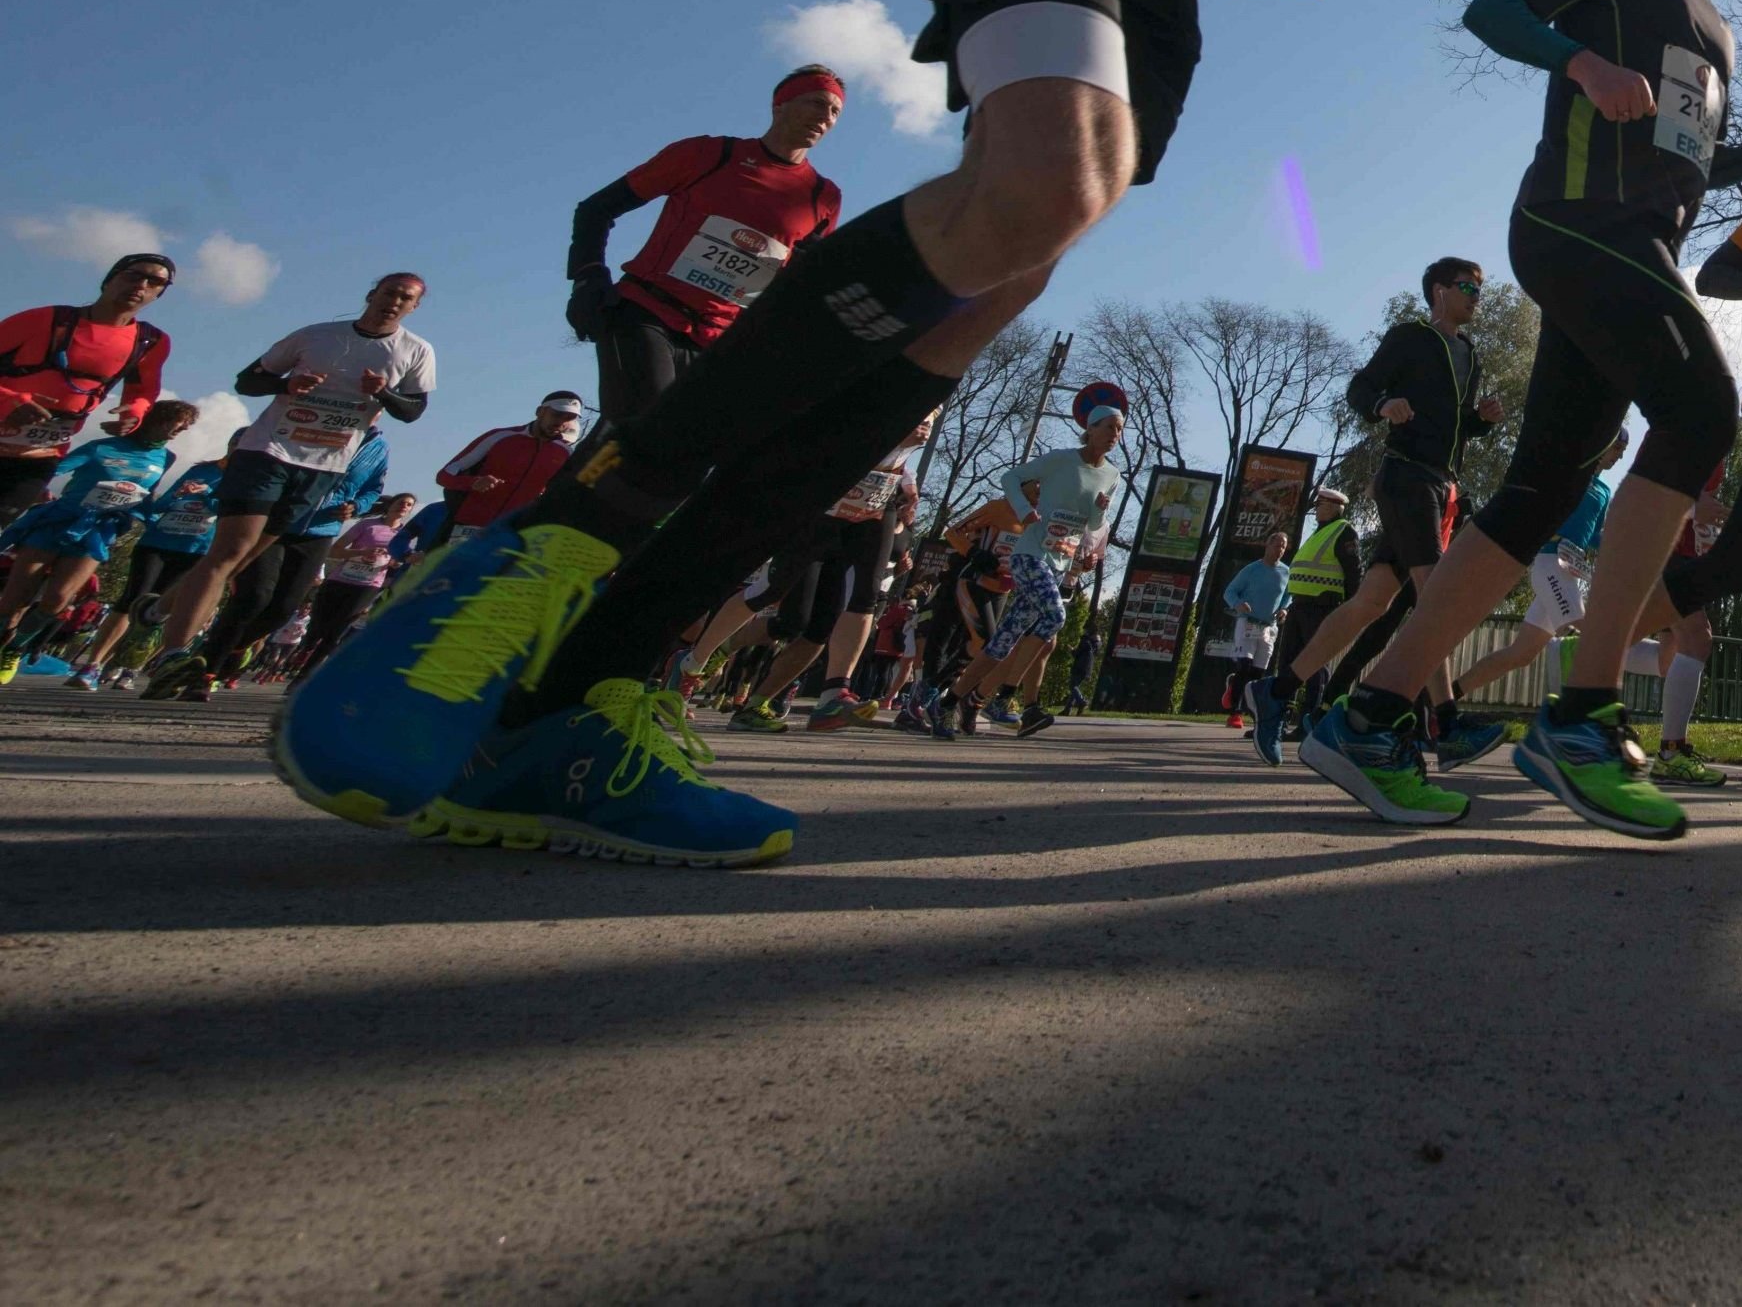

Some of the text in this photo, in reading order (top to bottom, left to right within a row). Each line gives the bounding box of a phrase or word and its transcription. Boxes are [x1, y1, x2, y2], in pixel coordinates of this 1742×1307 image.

[701, 244, 760, 278] 21827
[686, 268, 735, 297] ERSTE
[321, 413, 361, 428] 2902
[27, 427, 71, 442] 8783
[1238, 511, 1276, 525] PIZZA
[1234, 525, 1264, 538] ZEIT
[1547, 575, 1570, 615] skinfit
